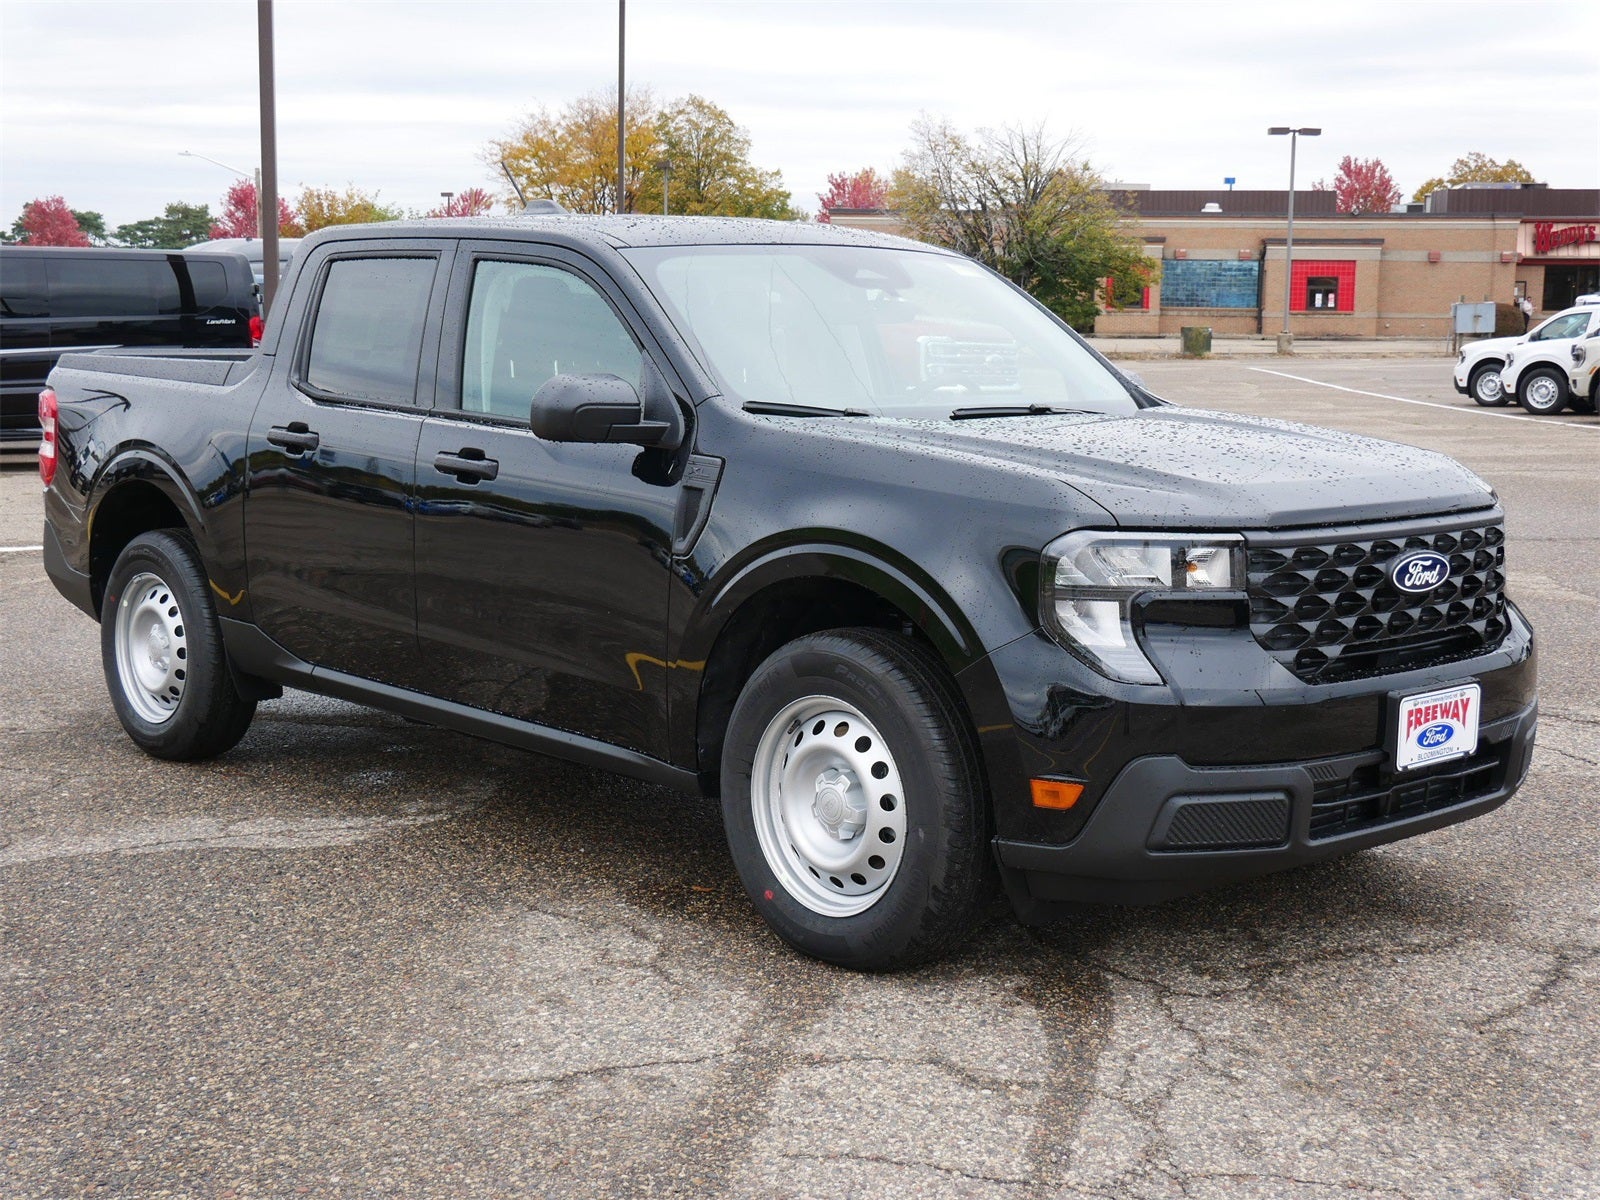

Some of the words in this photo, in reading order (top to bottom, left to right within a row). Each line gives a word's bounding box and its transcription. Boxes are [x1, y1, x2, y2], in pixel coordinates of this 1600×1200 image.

[1404, 560, 1440, 587] Ford
[1405, 697, 1471, 743] FREEWAY
[1422, 726, 1448, 746] Ford
[1417, 746, 1454, 761] BLOOMINGTON
